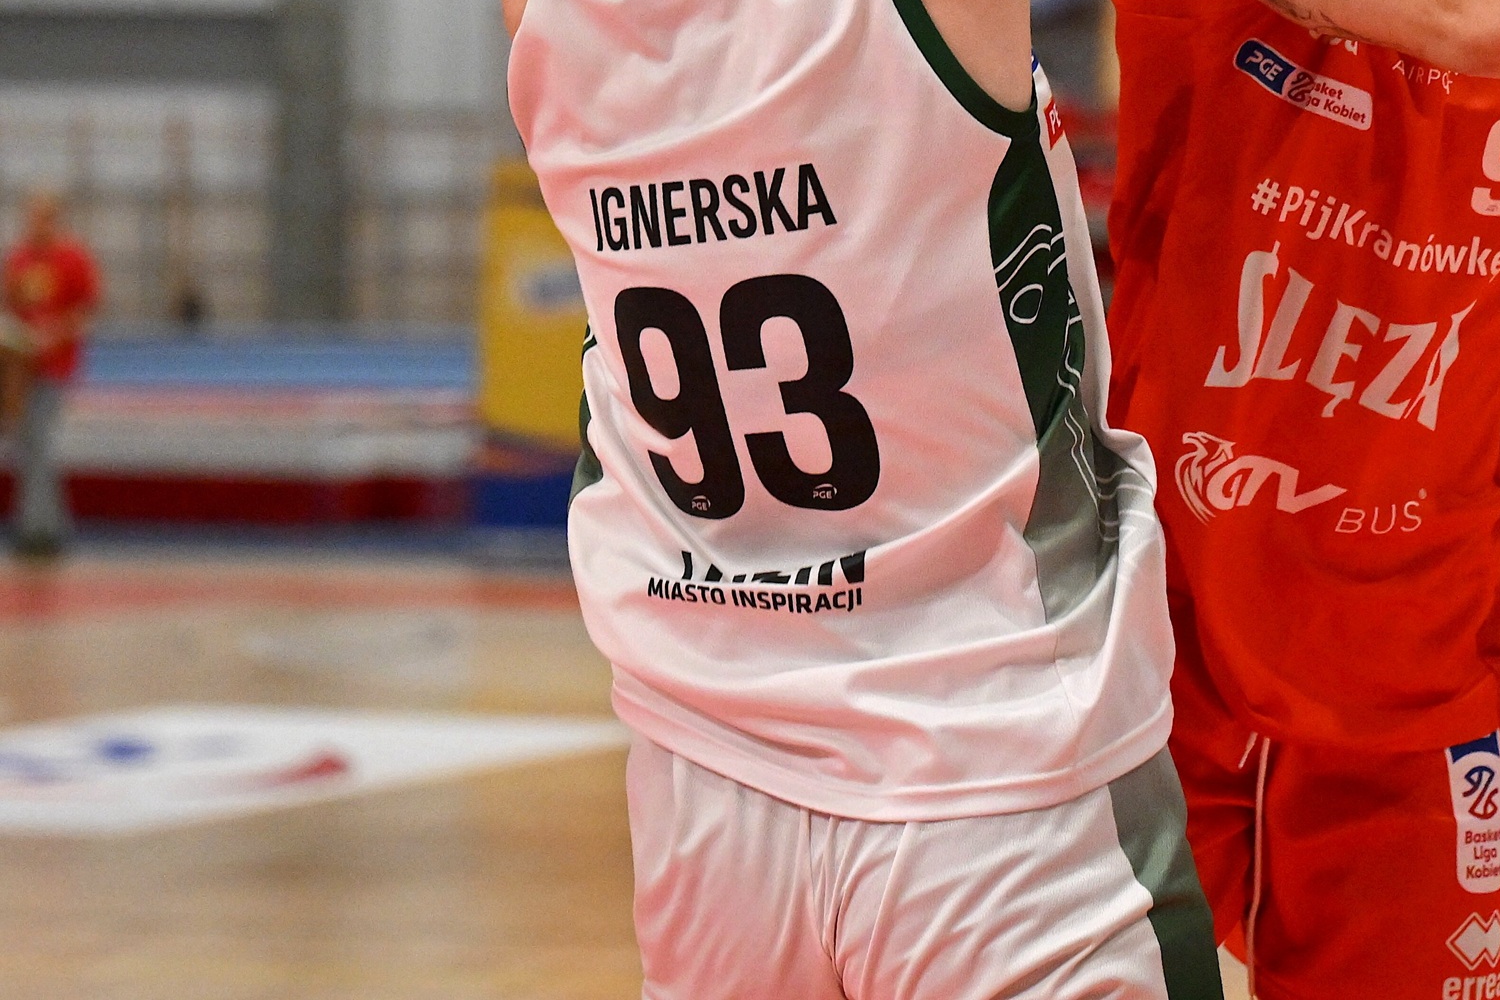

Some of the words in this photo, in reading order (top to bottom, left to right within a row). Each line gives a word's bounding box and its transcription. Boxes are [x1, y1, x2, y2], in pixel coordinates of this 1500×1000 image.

[1245, 49, 1284, 82] PGE
[1322, 99, 1367, 125] Kobiet
[589, 163, 837, 252] IGNERSKA
[614, 273, 881, 520] 93
[1334, 500, 1423, 536] BUS
[647, 576, 726, 605] MIASTO
[731, 586, 863, 614] INSPIRACJI
[1473, 845, 1498, 863] Liga
